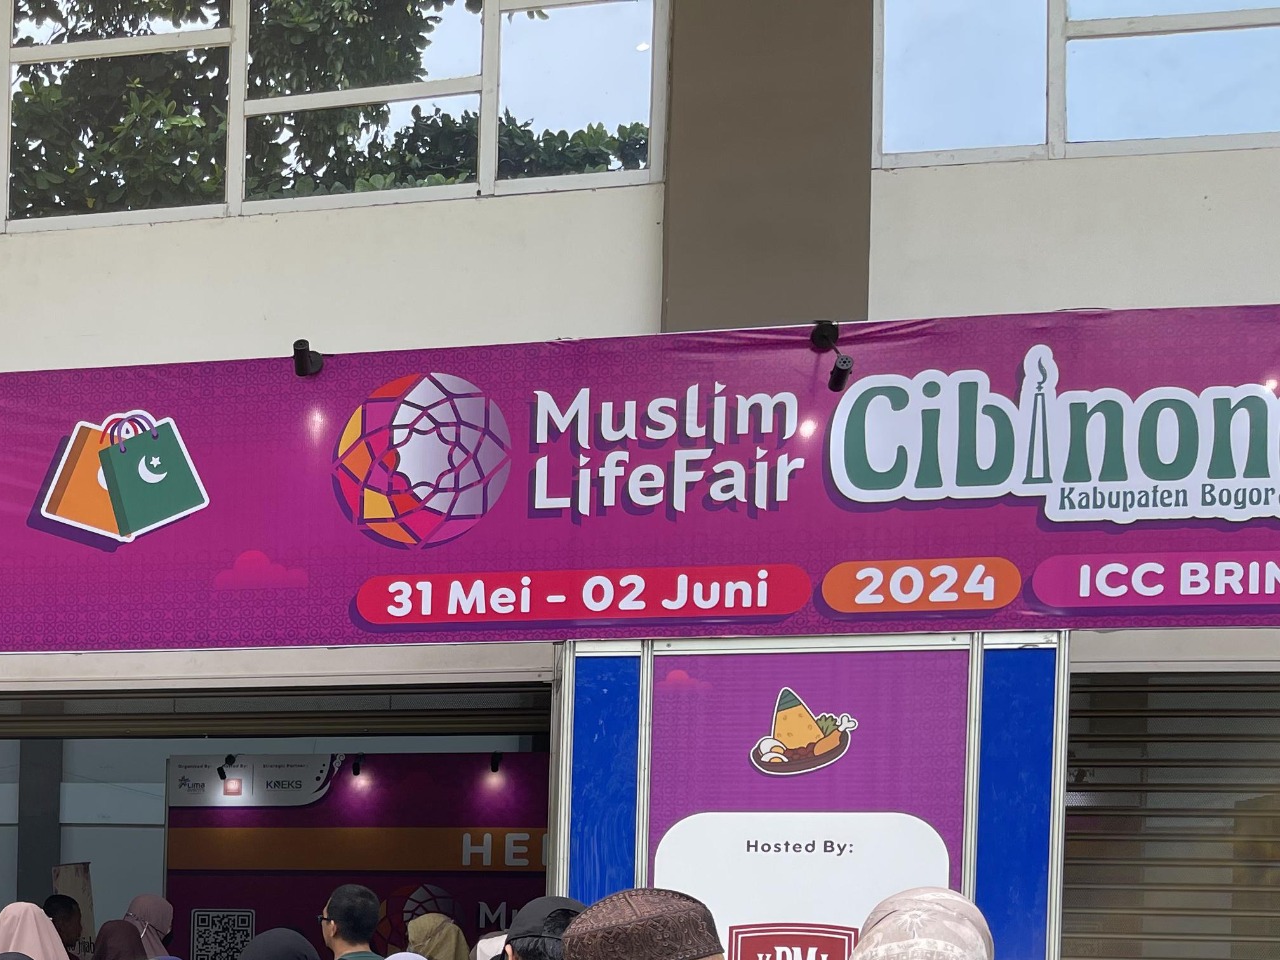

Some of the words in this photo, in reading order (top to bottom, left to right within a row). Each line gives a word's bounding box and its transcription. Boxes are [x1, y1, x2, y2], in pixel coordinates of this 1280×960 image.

[534, 380, 798, 449] Muslim
[844, 357, 1280, 490] Cibinon
[535, 447, 805, 516] LifeFair
[1059, 484, 1188, 512] Kabupaten
[1201, 483, 1275, 509] Bogor
[387, 581, 432, 617] 31
[448, 577, 531, 615] Mei
[582, 575, 646, 612] 02
[662, 570, 768, 609] Juni
[855, 564, 995, 604] 2024
[1079, 562, 1165, 597] ICC
[462, 832, 549, 866] HE
[746, 839, 816, 853] Hosted
[823, 839, 854, 857] By:
